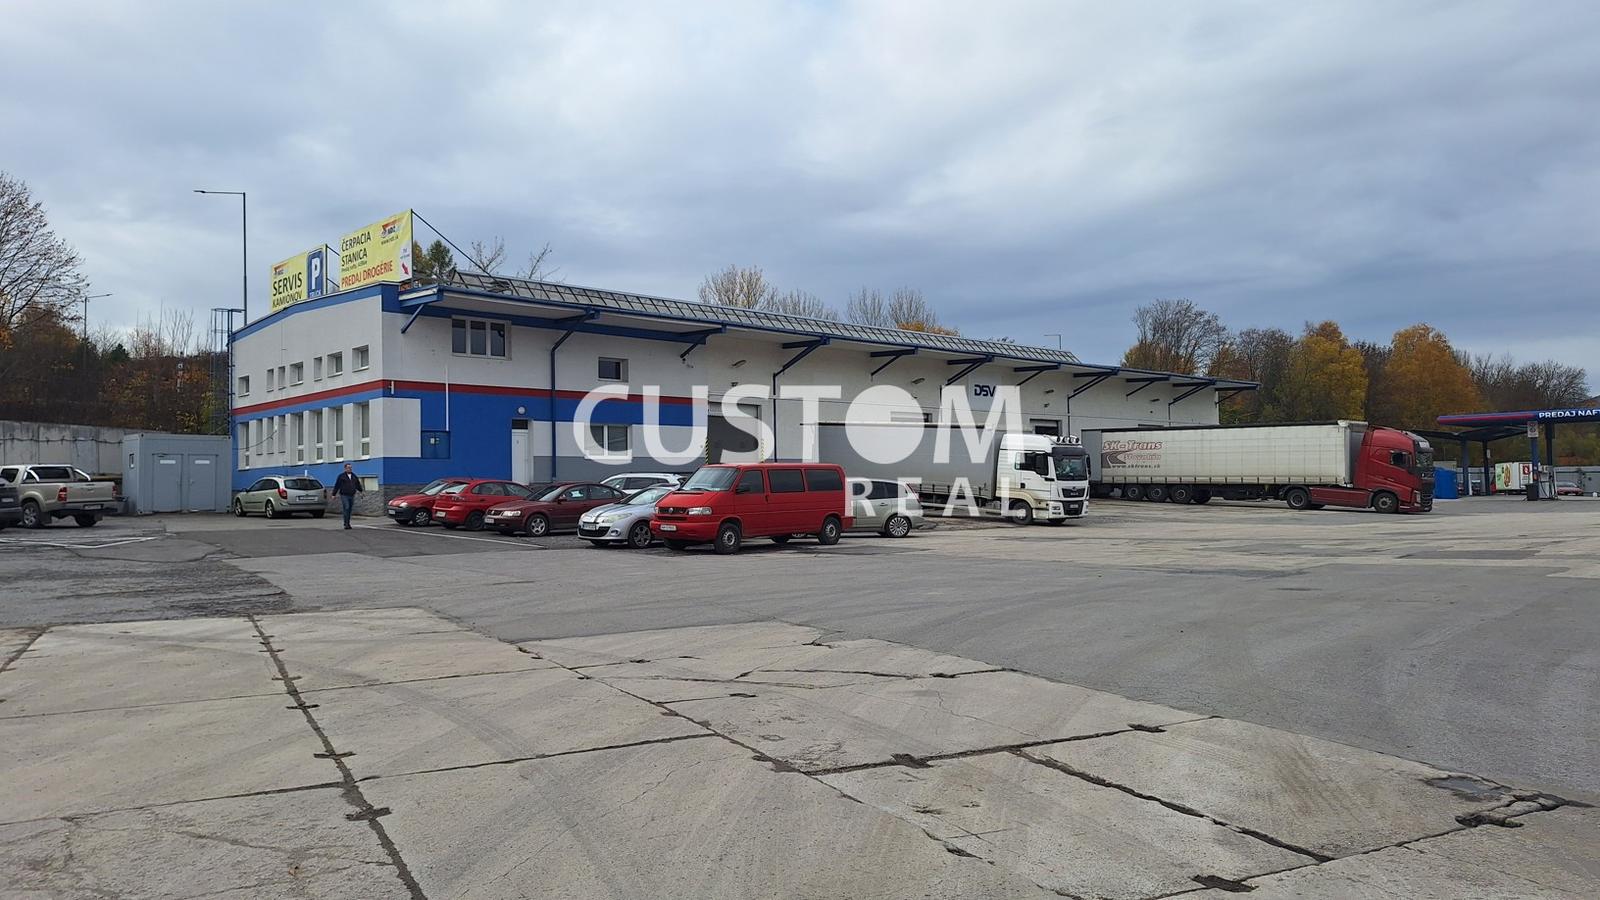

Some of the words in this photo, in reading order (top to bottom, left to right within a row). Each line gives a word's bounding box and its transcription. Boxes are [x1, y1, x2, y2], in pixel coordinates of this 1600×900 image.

[341, 231, 371, 252] ČERPACIA
[341, 247, 368, 267] STANICA
[311, 257, 320, 290] P
[341, 271, 362, 288] PREDAJ
[272, 271, 303, 297] SERVIS
[974, 384, 997, 397] DSV
[1538, 410, 1576, 418] PREDAJ
